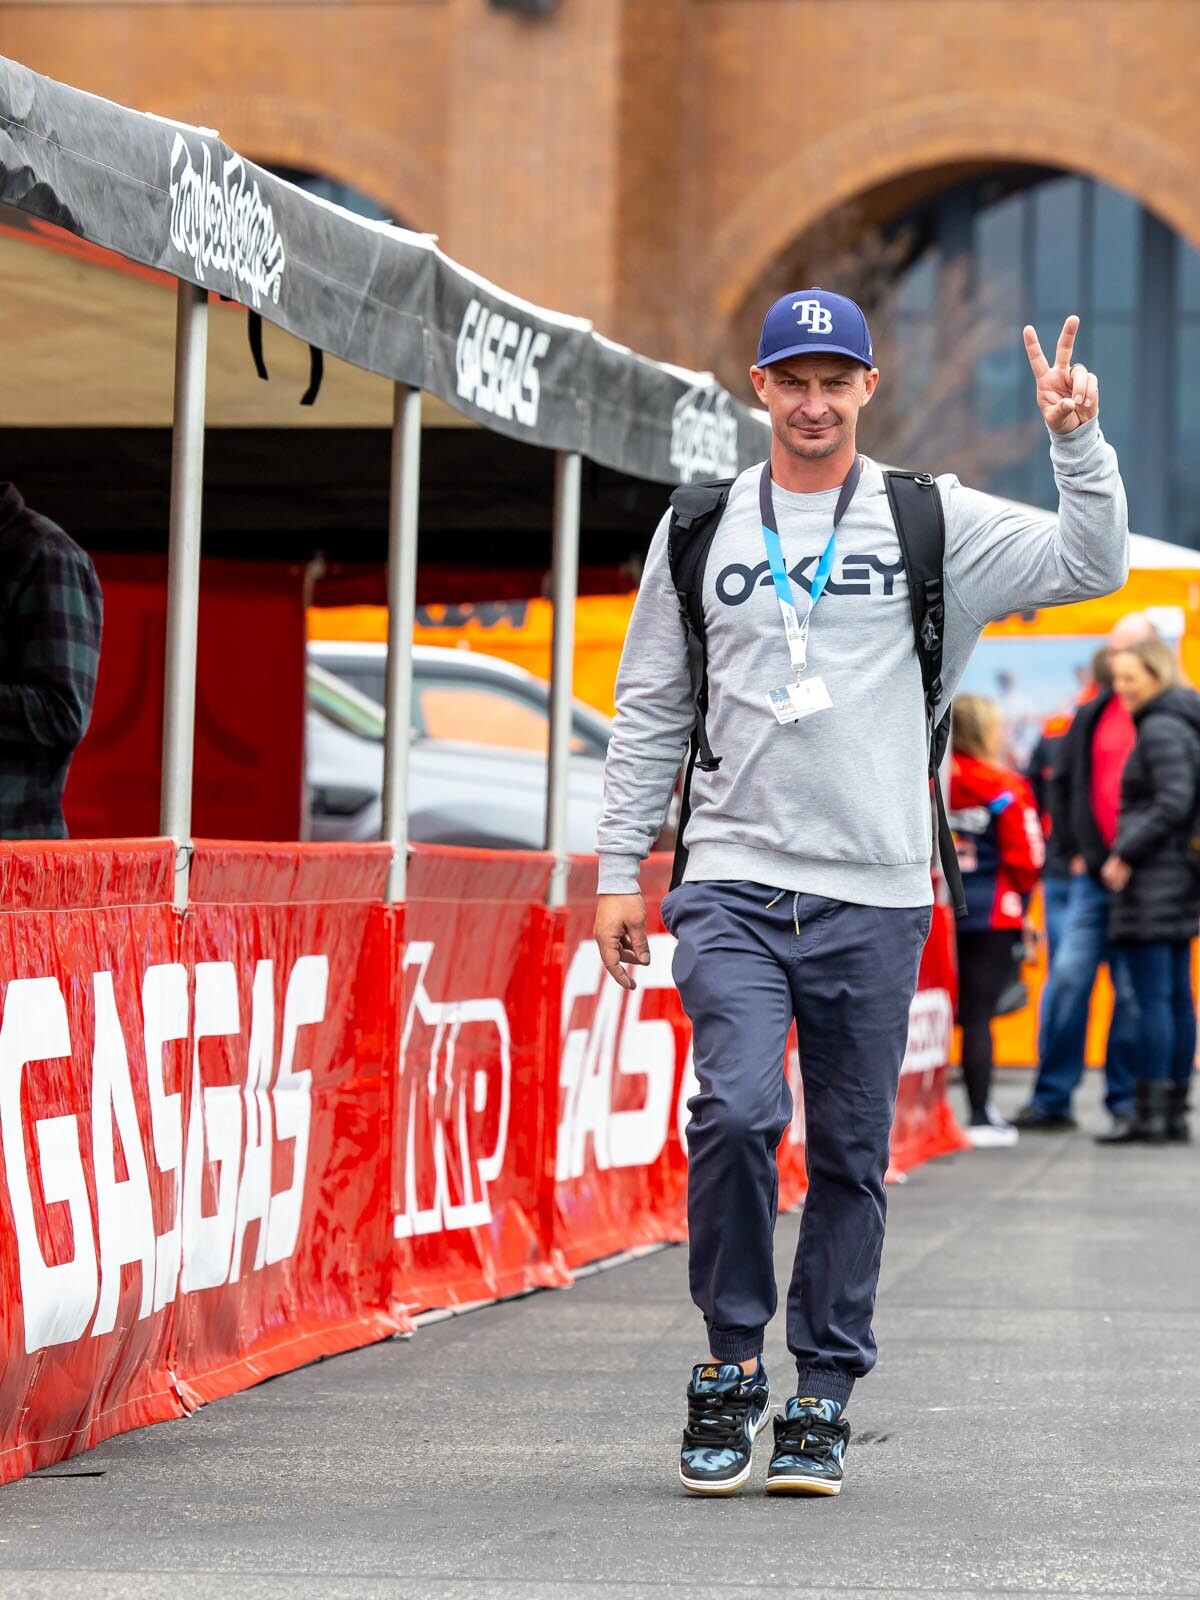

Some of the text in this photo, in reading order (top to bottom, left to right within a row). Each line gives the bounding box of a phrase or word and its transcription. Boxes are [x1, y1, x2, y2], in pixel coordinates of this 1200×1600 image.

[455, 298, 552, 428] GASGAS
[791, 299, 833, 335] TB
[555, 933, 702, 1182] GAS
[0, 955, 329, 1355] GASGAS
